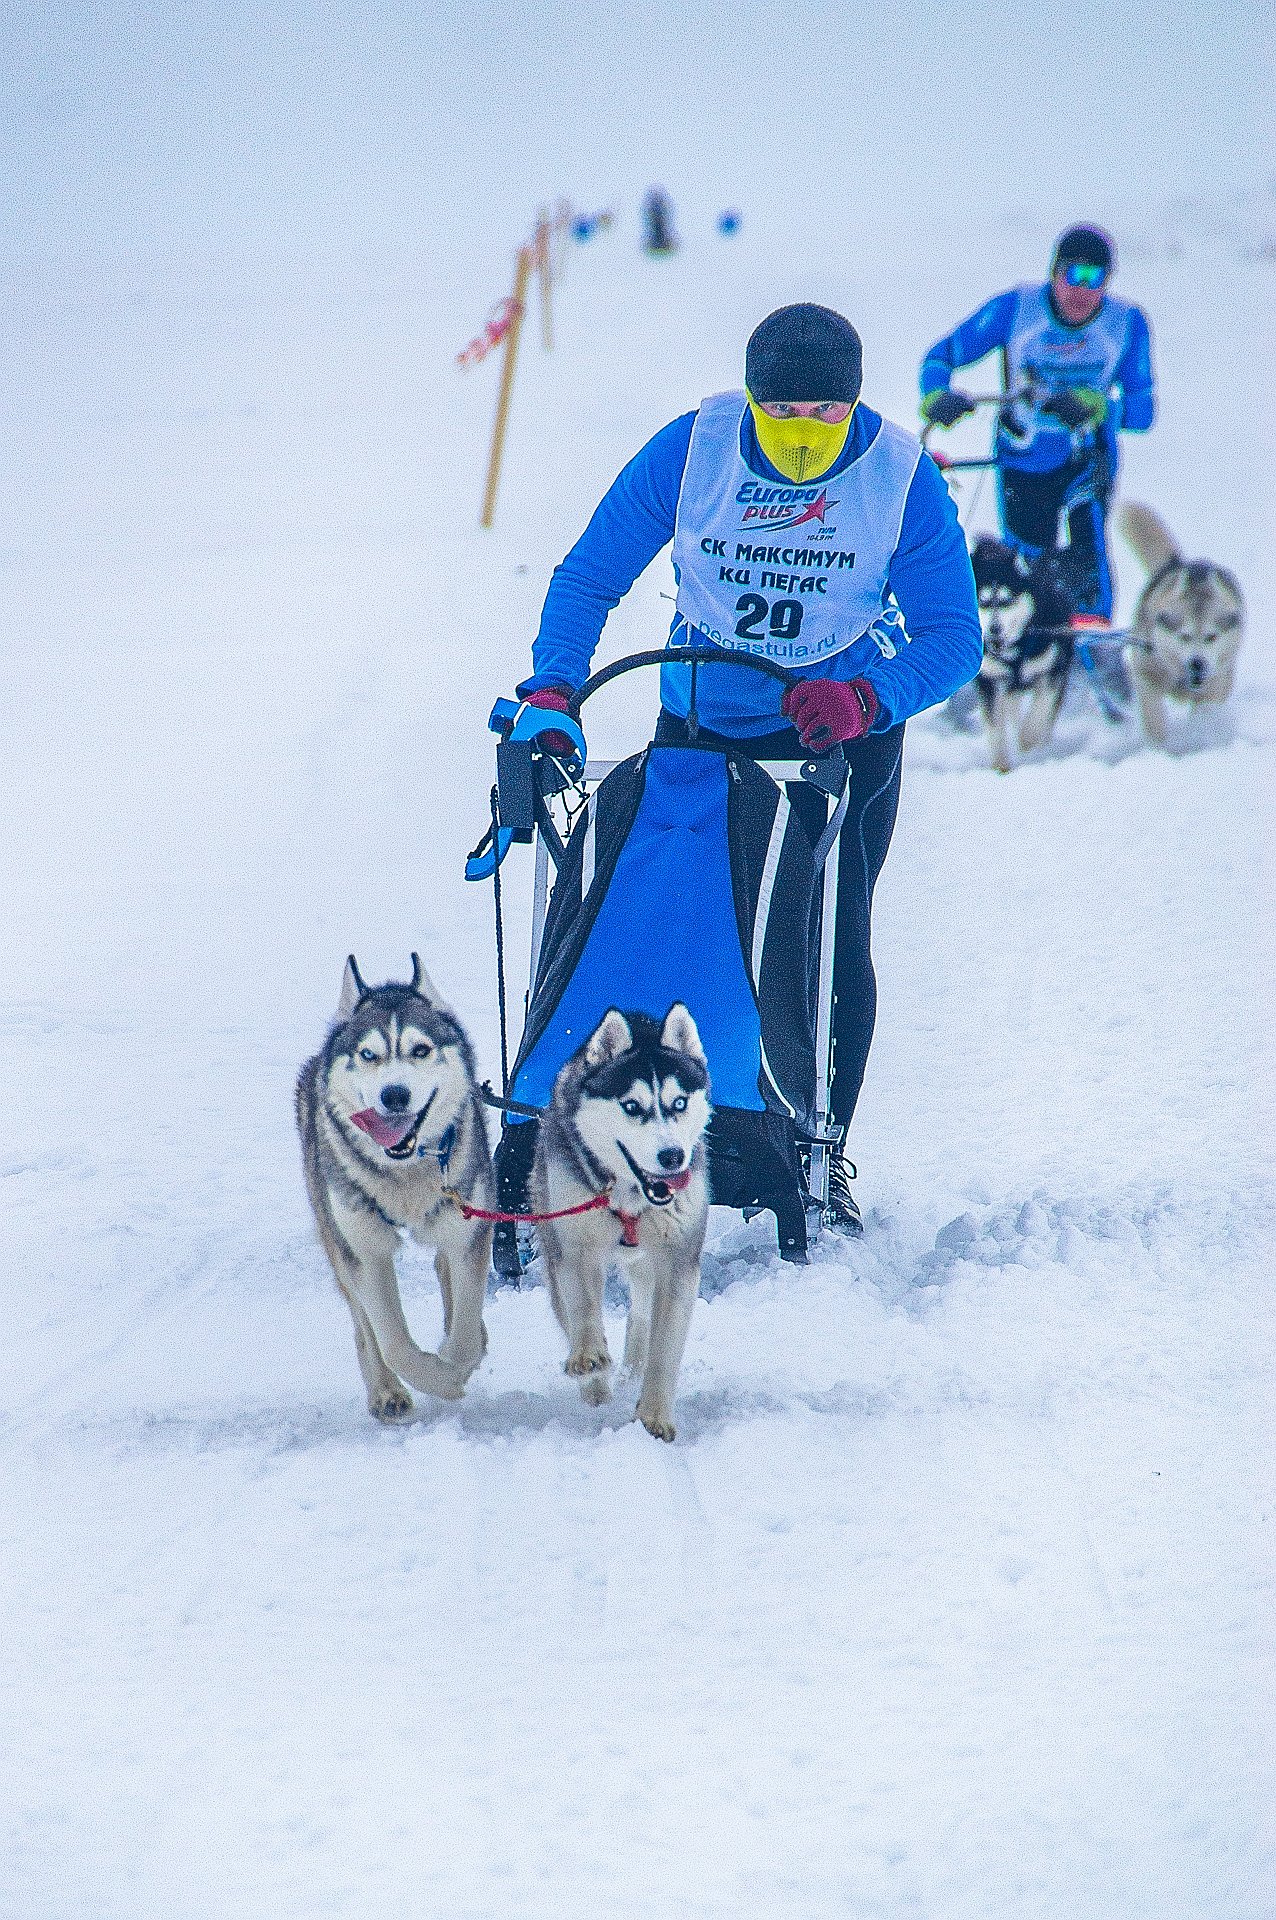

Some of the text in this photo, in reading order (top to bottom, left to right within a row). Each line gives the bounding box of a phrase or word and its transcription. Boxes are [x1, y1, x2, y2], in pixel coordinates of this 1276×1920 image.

[735, 481, 818, 503] Europa
[741, 504, 797, 521] plus
[700, 537, 856, 569] СК МАКСИМУМ
[760, 571, 828, 594] ПЕГАС
[734, 592, 804, 640] 29
